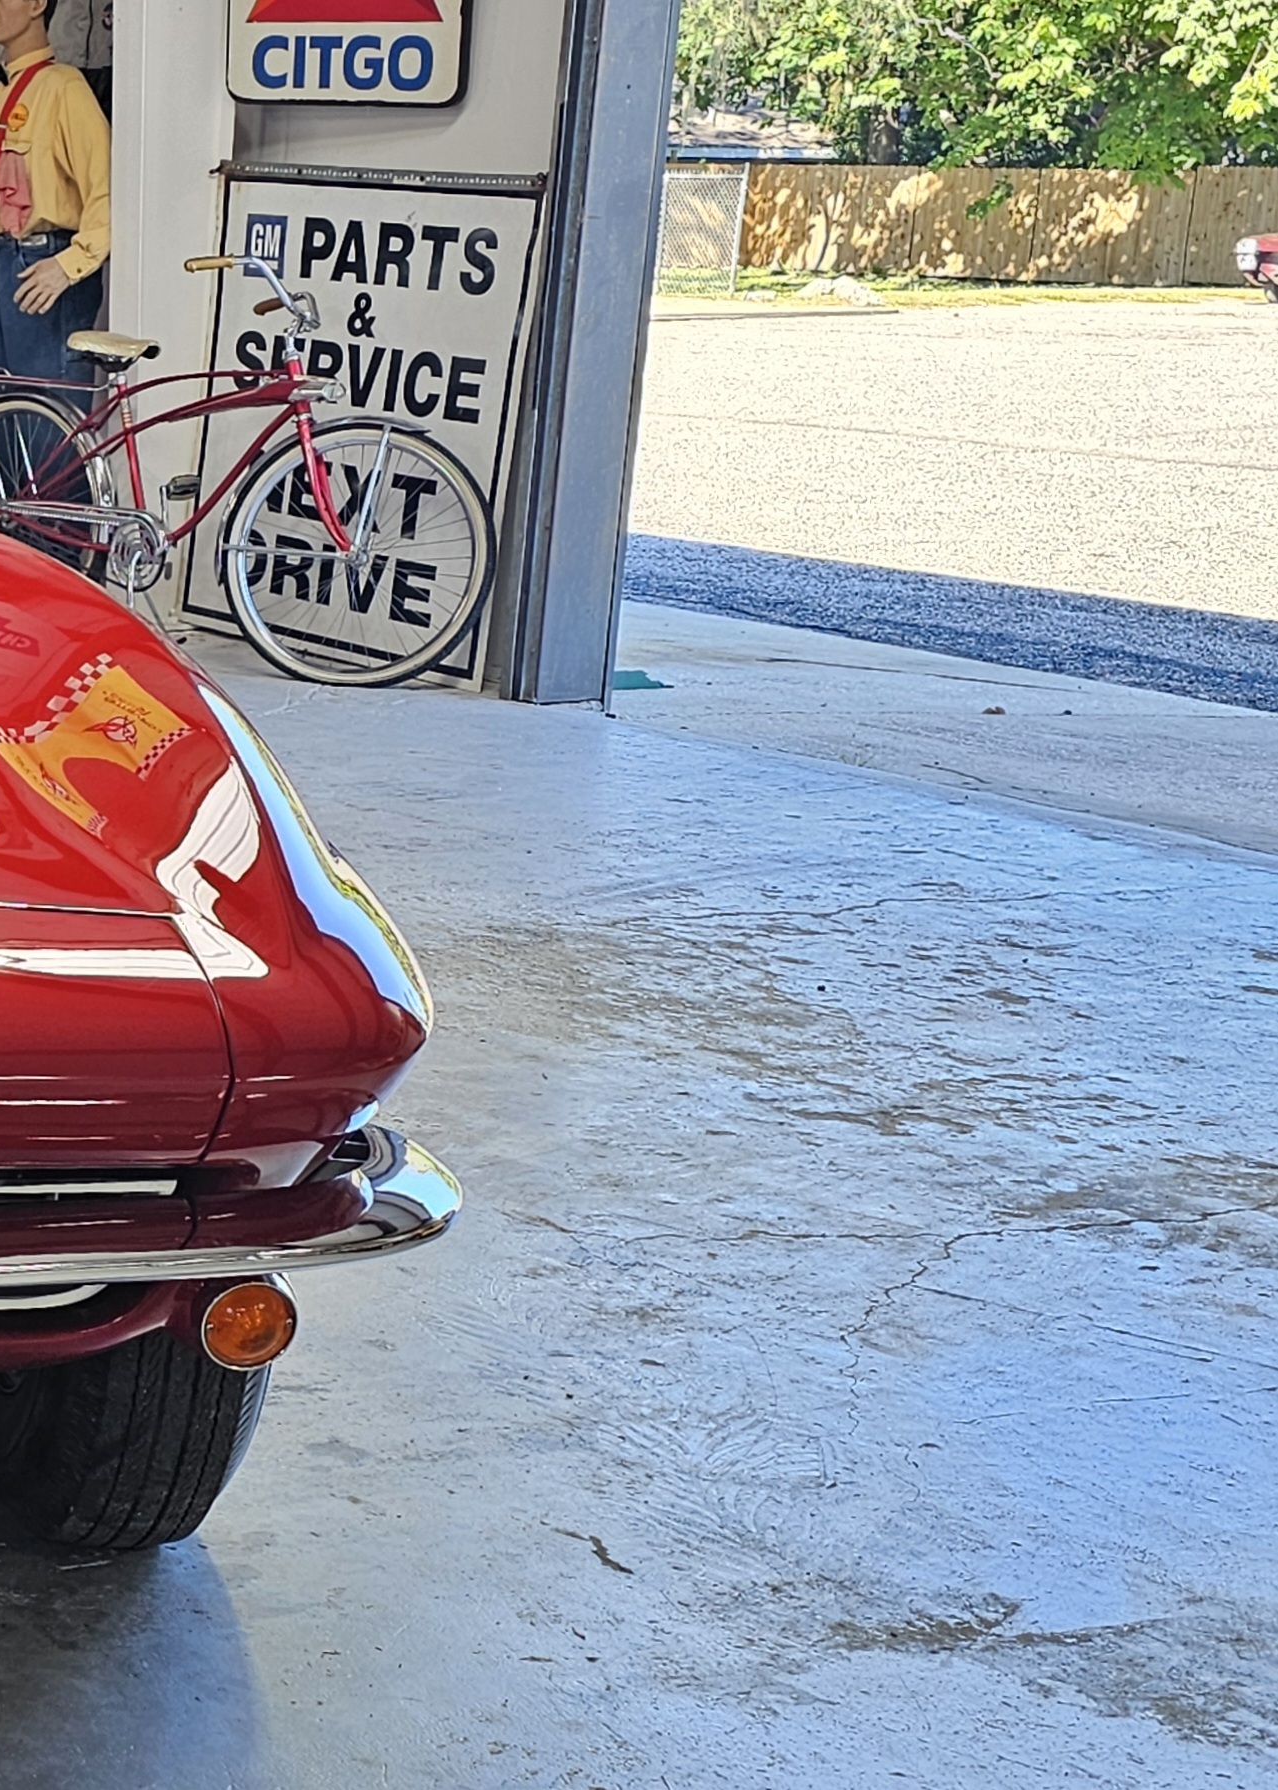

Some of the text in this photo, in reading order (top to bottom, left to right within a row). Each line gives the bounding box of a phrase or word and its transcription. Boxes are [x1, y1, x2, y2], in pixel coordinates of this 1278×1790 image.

[251, 34, 434, 92] CITGO
[250, 216, 499, 296] GM PARTS
[347, 292, 375, 338] &
